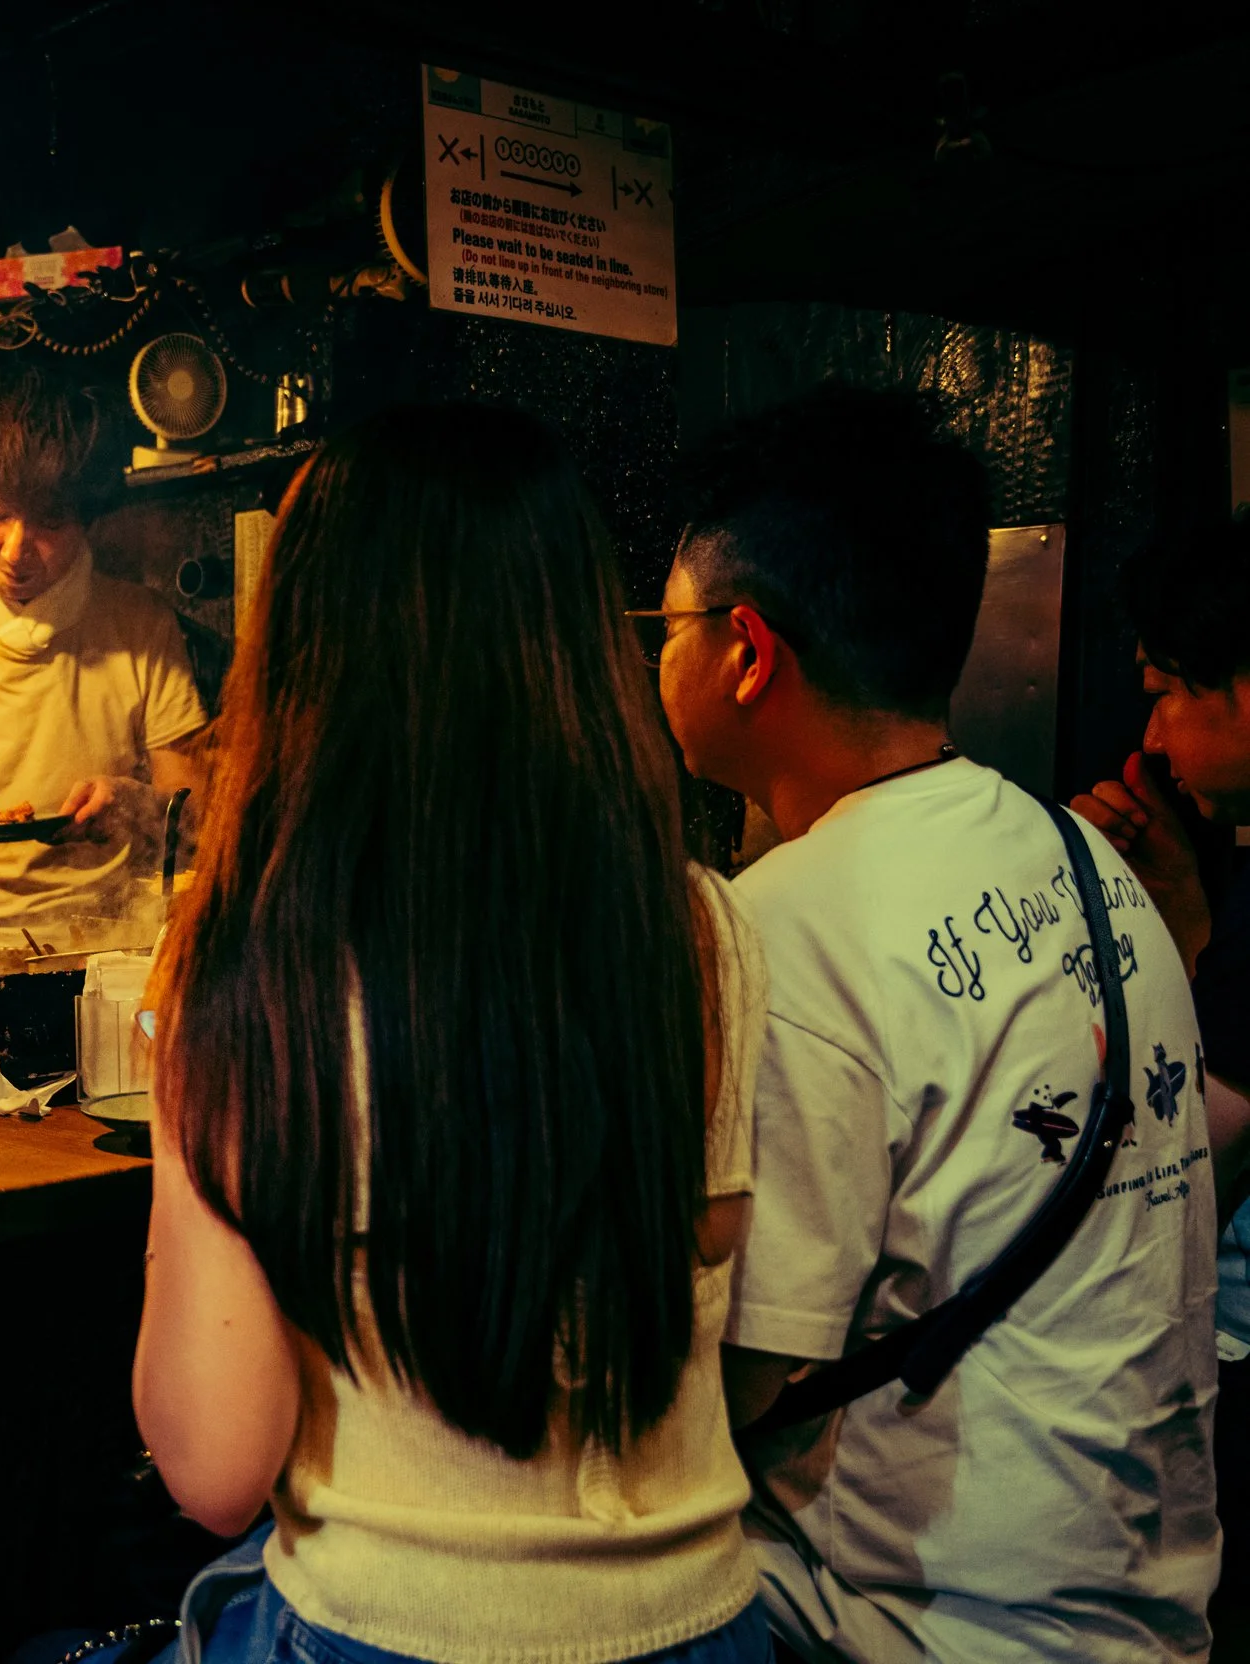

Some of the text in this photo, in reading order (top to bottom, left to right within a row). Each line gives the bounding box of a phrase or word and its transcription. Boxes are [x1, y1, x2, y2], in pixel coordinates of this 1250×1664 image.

[452, 228, 634, 276] Please wait to be seated in line.
[461, 248, 669, 300] (Do not line up in front of the neighboring store)
[452, 266, 539, 296] 请排队等待入座。
[453, 287, 578, 321] 줄을 서서 기다려 주십시오.
[927, 915, 987, 1002] If
[973, 886, 1061, 964] You
